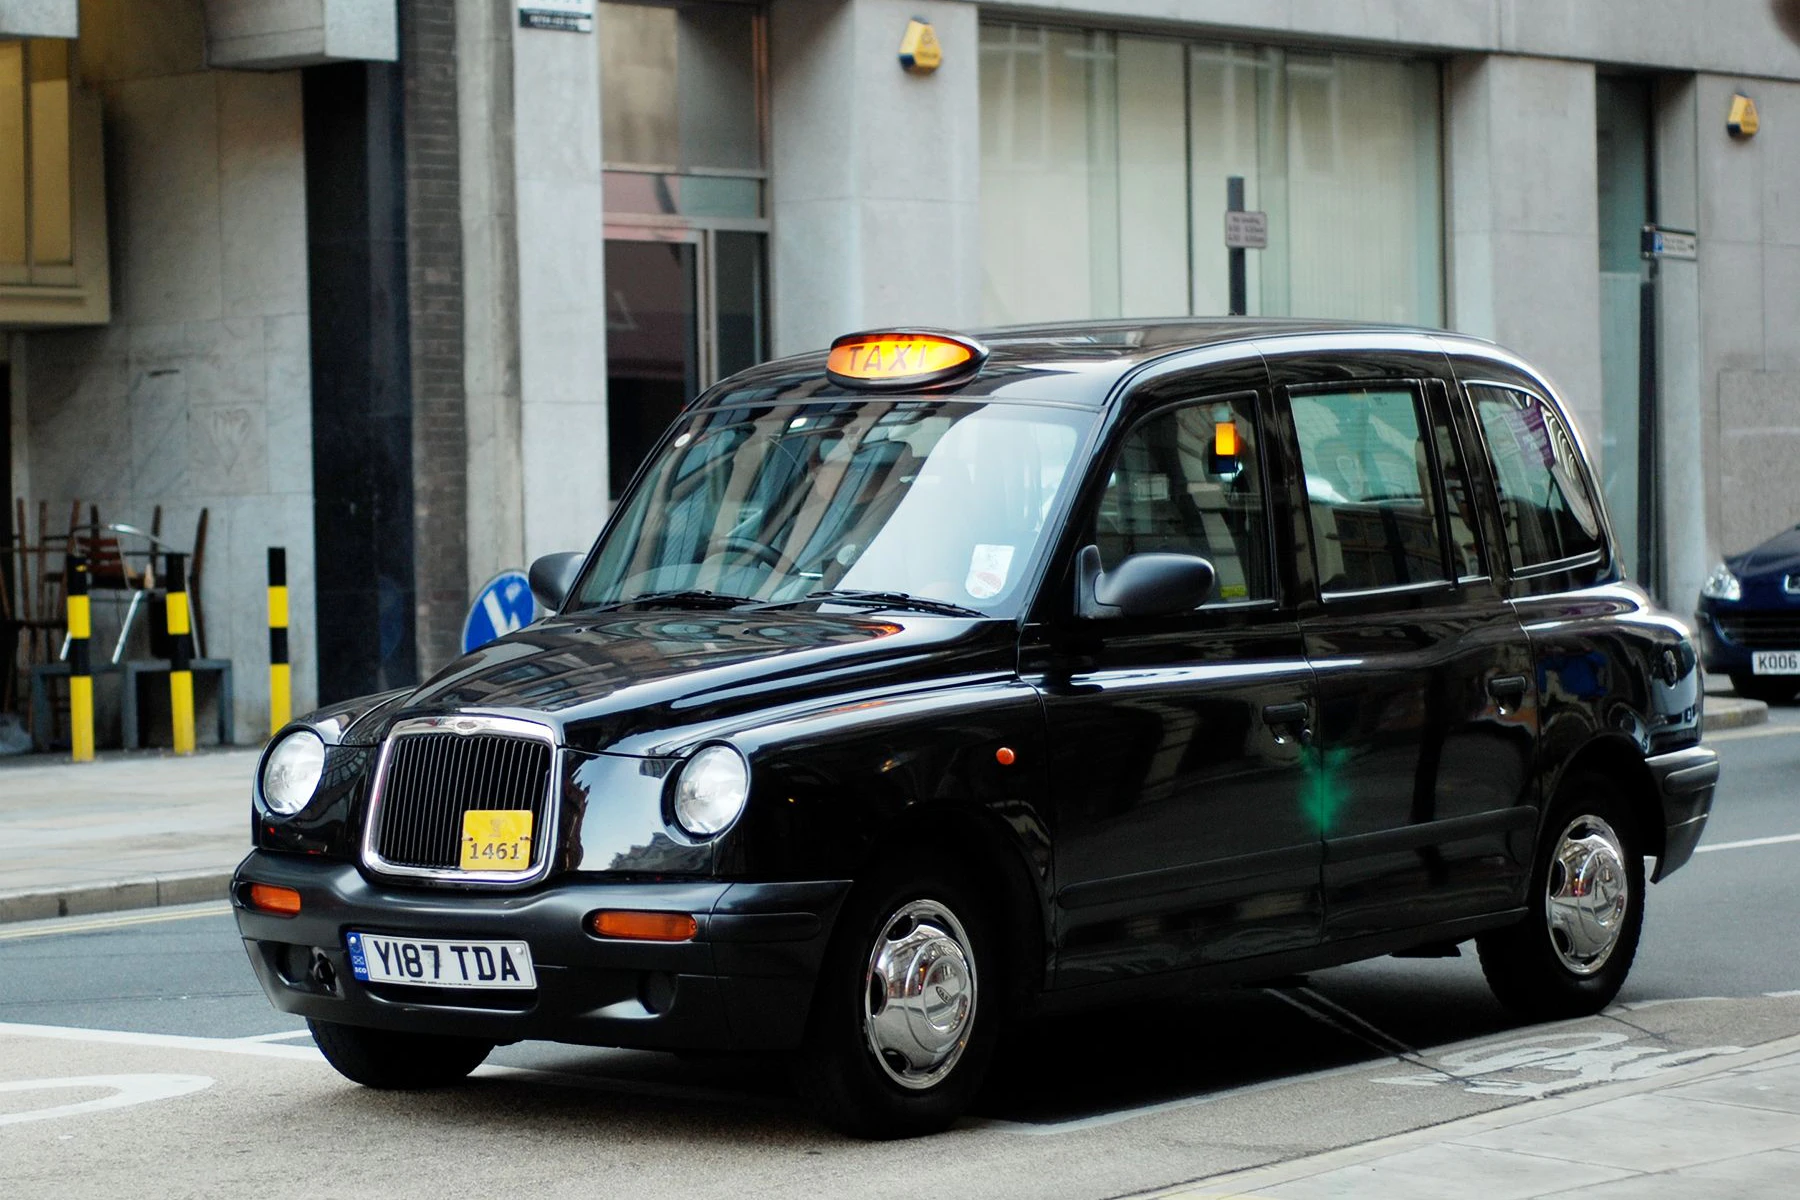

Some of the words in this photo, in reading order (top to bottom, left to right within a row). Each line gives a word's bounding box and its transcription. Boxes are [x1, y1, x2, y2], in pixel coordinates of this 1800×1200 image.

[849, 344, 928, 371] TAXI
[469, 842, 520, 860] 1461
[373, 940, 441, 979] Y187
[450, 945, 521, 982] TDA
